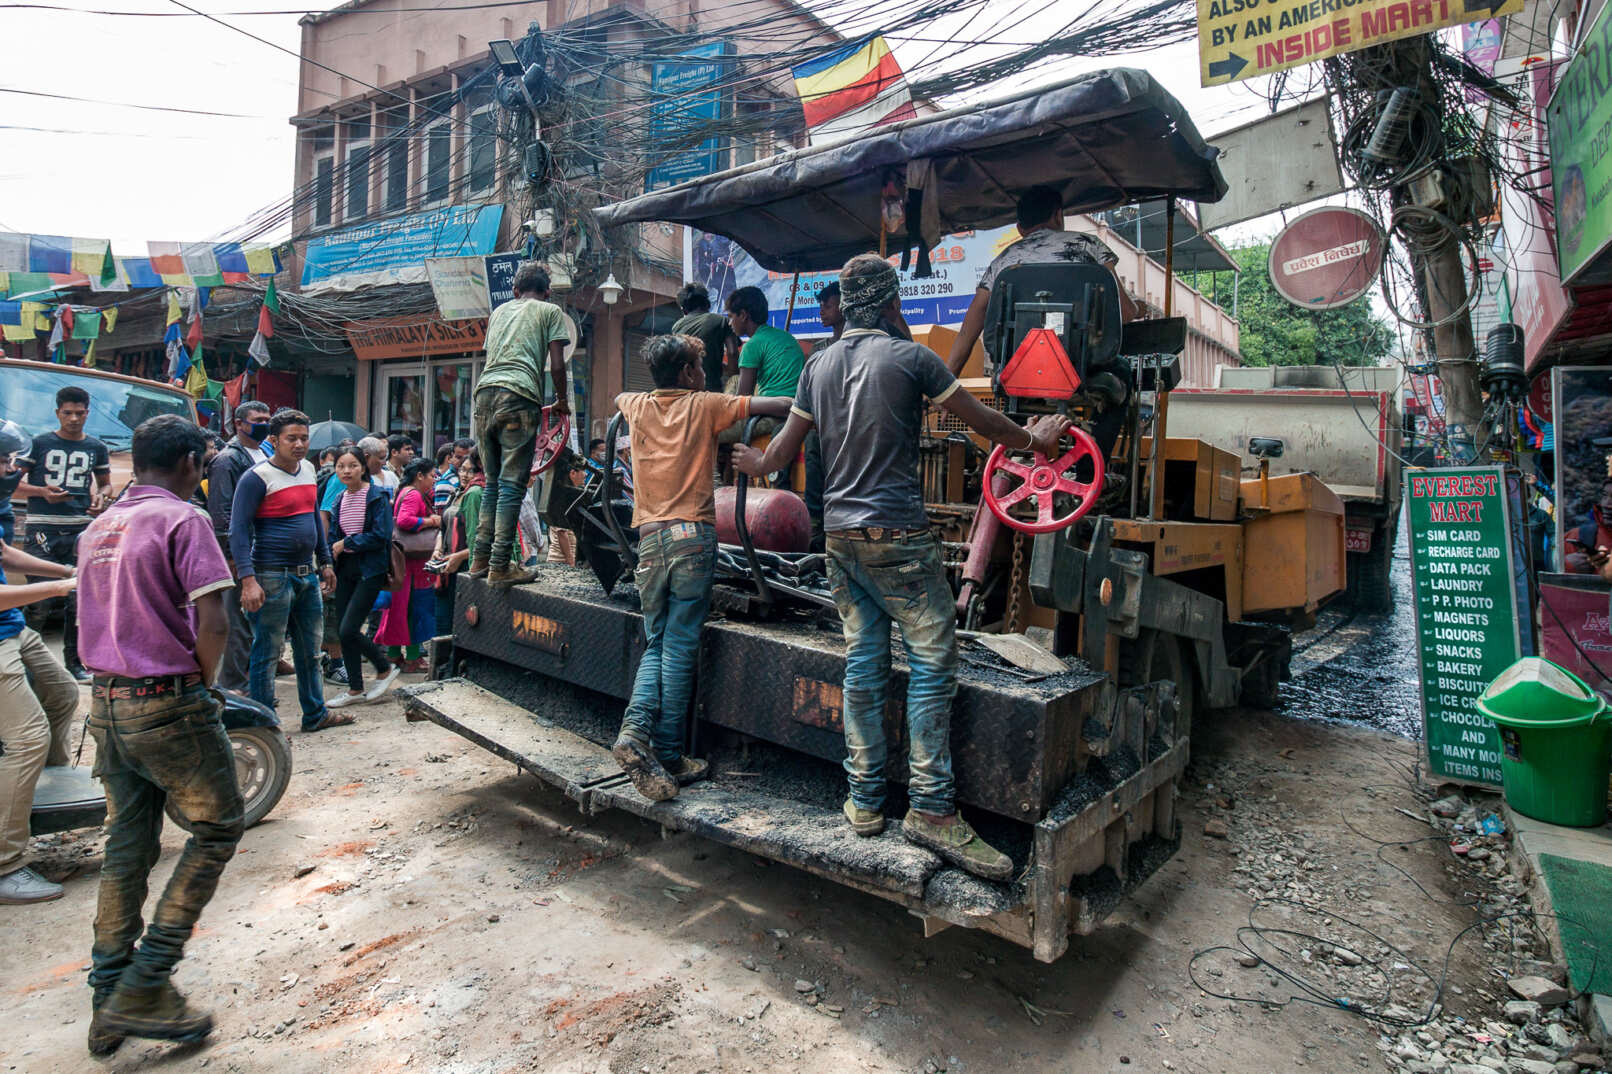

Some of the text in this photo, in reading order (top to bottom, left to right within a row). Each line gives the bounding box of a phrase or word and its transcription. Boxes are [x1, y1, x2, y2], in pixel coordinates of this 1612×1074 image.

[1212, 24, 1237, 47] BY
[1244, 16, 1272, 39] AN
[1256, 0, 1449, 69] INSIDE MART
[797, 296, 815, 305] More
[920, 285, 936, 295] 320
[937, 283, 953, 294] 290
[803, 282, 811, 291] &
[434, 319, 466, 341] SILK
[44, 449, 90, 488] 92
[1412, 475, 1498, 497] EVEREST
[1429, 501, 1483, 523] MART
[1427, 530, 1481, 542] SIM CARD
[1428, 546, 1500, 559] RECHARGE CARD
[1430, 562, 1492, 576] DATA PACK
[1431, 578, 1484, 592] LAUNDRY
[1454, 596, 1494, 609] PHOTO
[1434, 611, 1489, 626] MAGNETS
[1435, 627, 1486, 643] LIQUORS
[1436, 644, 1482, 659] SNACKS
[1437, 660, 1483, 676] BAKERY
[1440, 693, 1459, 707] ICE
[1441, 710, 1497, 729] CHOCOLA
[1461, 730, 1486, 744] AND
[1443, 743, 1476, 760] MANY
[1444, 760, 1480, 778] ITEMS
